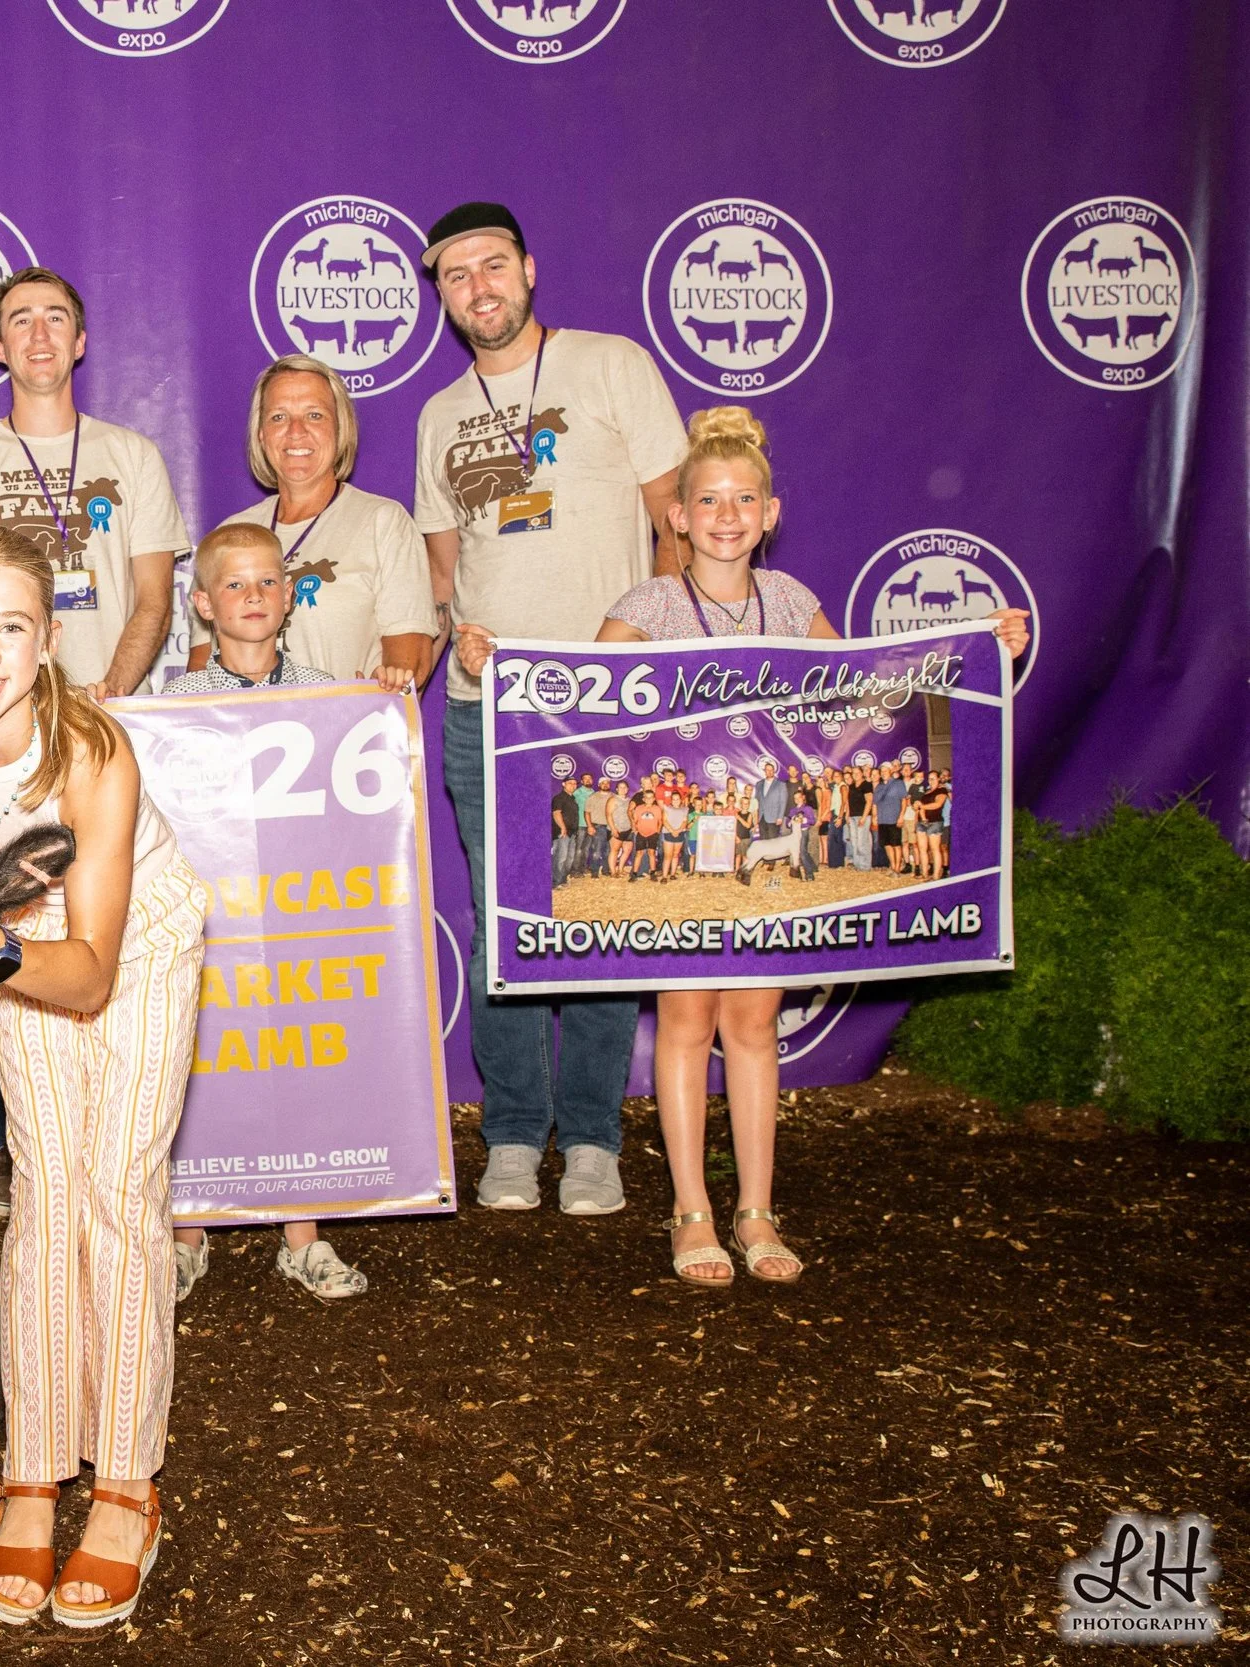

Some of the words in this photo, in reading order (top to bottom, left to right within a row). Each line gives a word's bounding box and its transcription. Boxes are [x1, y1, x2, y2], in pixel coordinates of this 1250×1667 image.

[117, 28, 166, 51] expo
[516, 35, 562, 58] expo
[898, 41, 943, 63] expo
[304, 201, 390, 228] michigan
[696, 203, 778, 230] michigan
[1074, 201, 1159, 229] michigan
[280, 286, 416, 309] LIVESTOCK
[672, 286, 803, 311] LIVESTOCK
[1051, 283, 1178, 308] LIVESTOCK
[342, 373, 375, 392] xpo
[720, 369, 765, 390] expo
[1101, 363, 1145, 385] expo
[457, 404, 521, 433] MEAT
[458, 432, 472, 440] US
[475, 428, 490, 436] AT
[538, 437, 550, 448] m
[452, 433, 526, 469] FAIR
[0, 467, 71, 484] MEAT
[0, 496, 82, 520] FAIR
[95, 504, 106, 514] m
[897, 534, 981, 560] michigan
[301, 581, 314, 590] m
[535, 682, 572, 691] LIVESTOCK
[669, 660, 793, 709] Natalie
[800, 651, 963, 710] Albright
[771, 704, 879, 724] Coldwater
[206, 864, 411, 919] WCASE
[516, 918, 724, 956] SHOWCASE
[733, 911, 881, 950] MARKET
[886, 903, 982, 941] LAMB
[197, 953, 386, 1010] ARKET
[258, 1152, 317, 1172] BUILD
[329, 1147, 389, 1167] GROW
[171, 1185, 192, 1199] UR
[196, 1181, 250, 1197] YOUTH,
[255, 1179, 287, 1194] OUR
[290, 1172, 396, 1192] AGRICULTURE
